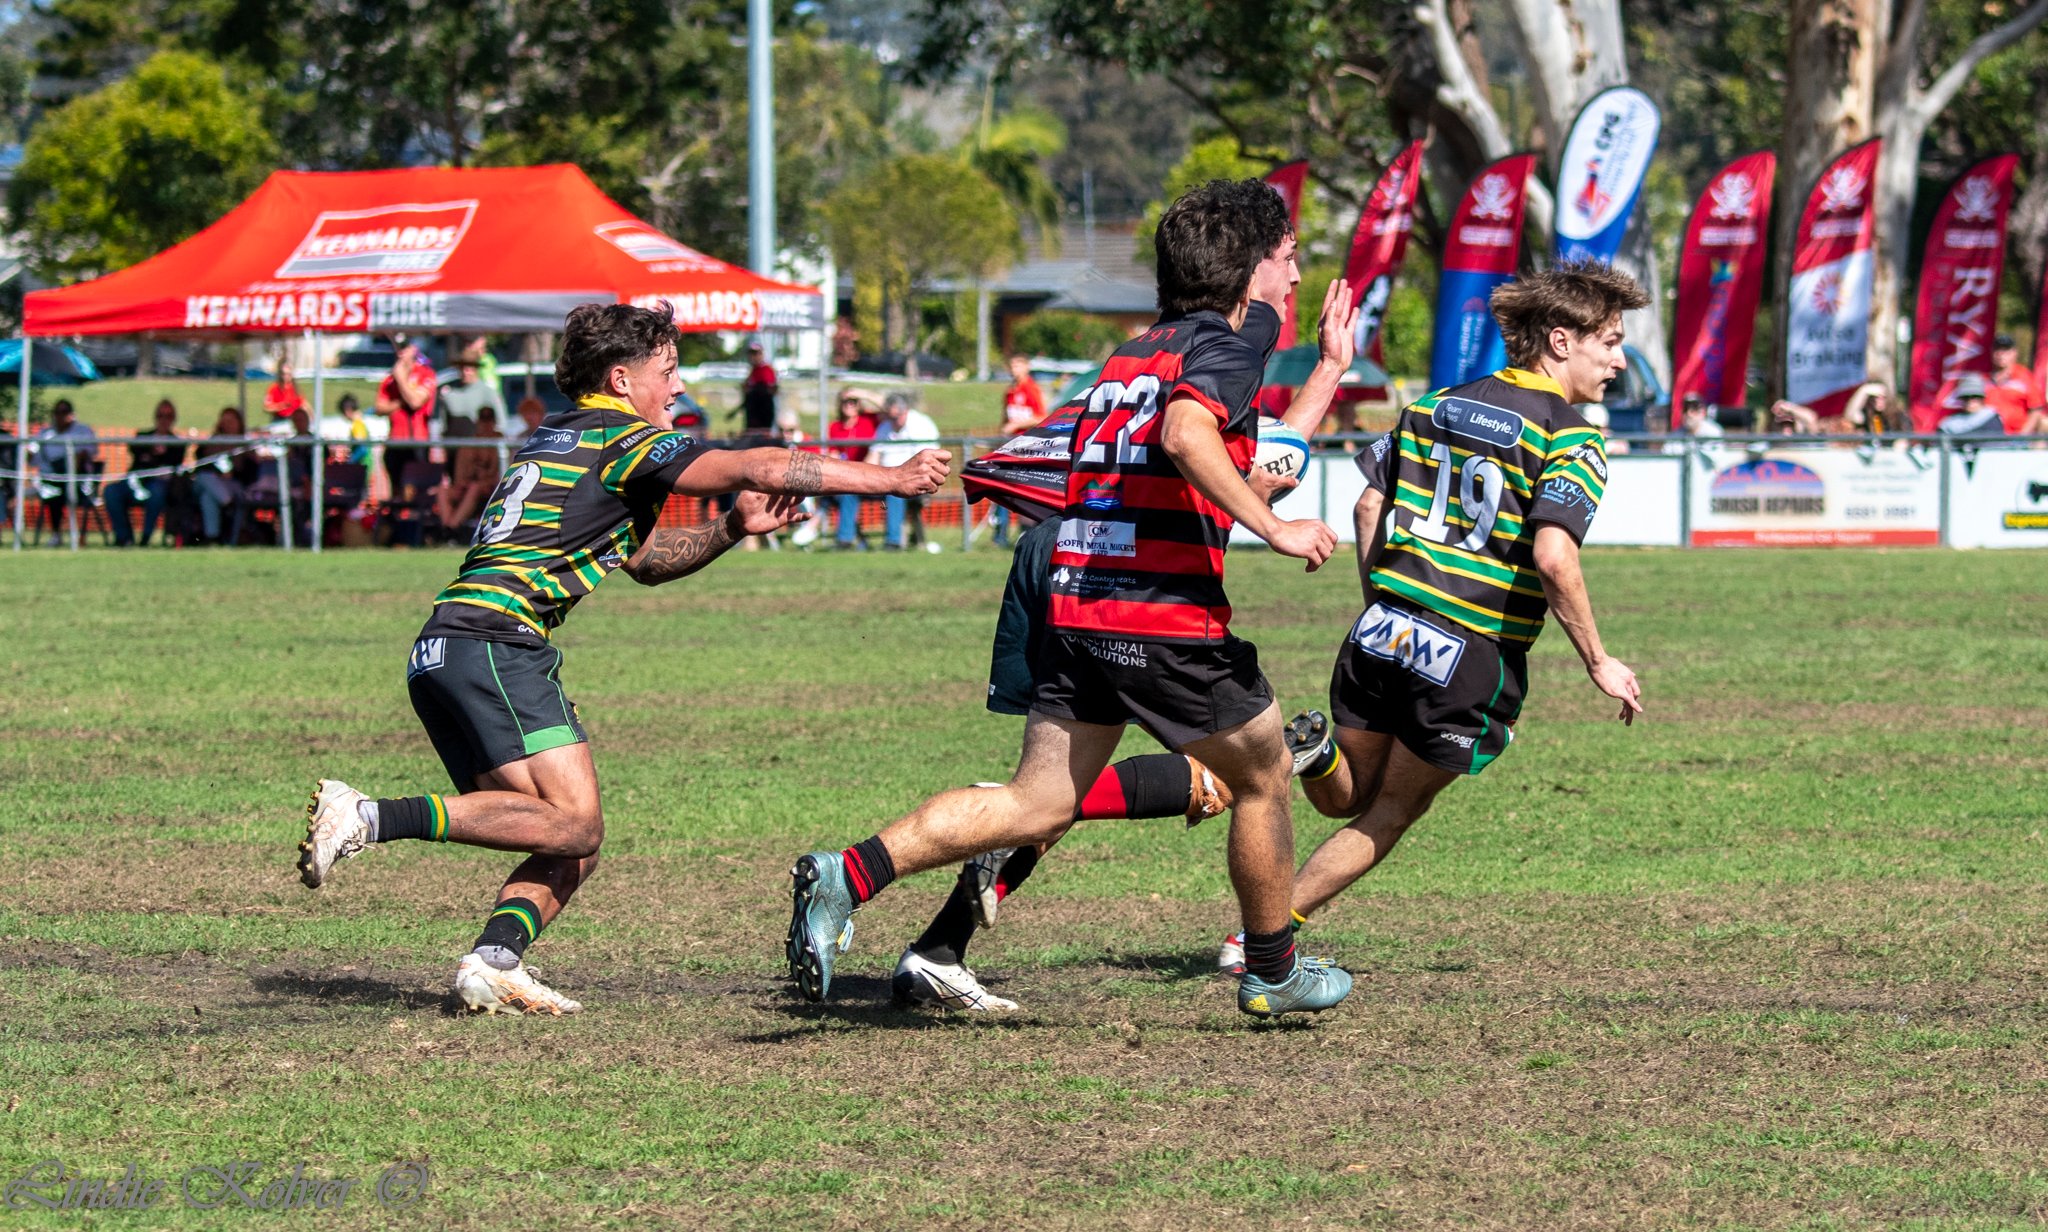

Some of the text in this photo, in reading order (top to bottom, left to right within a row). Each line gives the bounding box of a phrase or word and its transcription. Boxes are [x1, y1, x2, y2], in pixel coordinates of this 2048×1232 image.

[303, 226, 458, 255] KENNARDS
[184, 292, 448, 327] KENNARDS HIRE
[1077, 374, 1161, 465] 22
[1469, 412, 1513, 435] Lifestyle.
[1259, 453, 1295, 476] RT
[470, 461, 541, 544] 3
[1409, 442, 1504, 552] 19
[1440, 731, 1476, 746] GOOSEY
